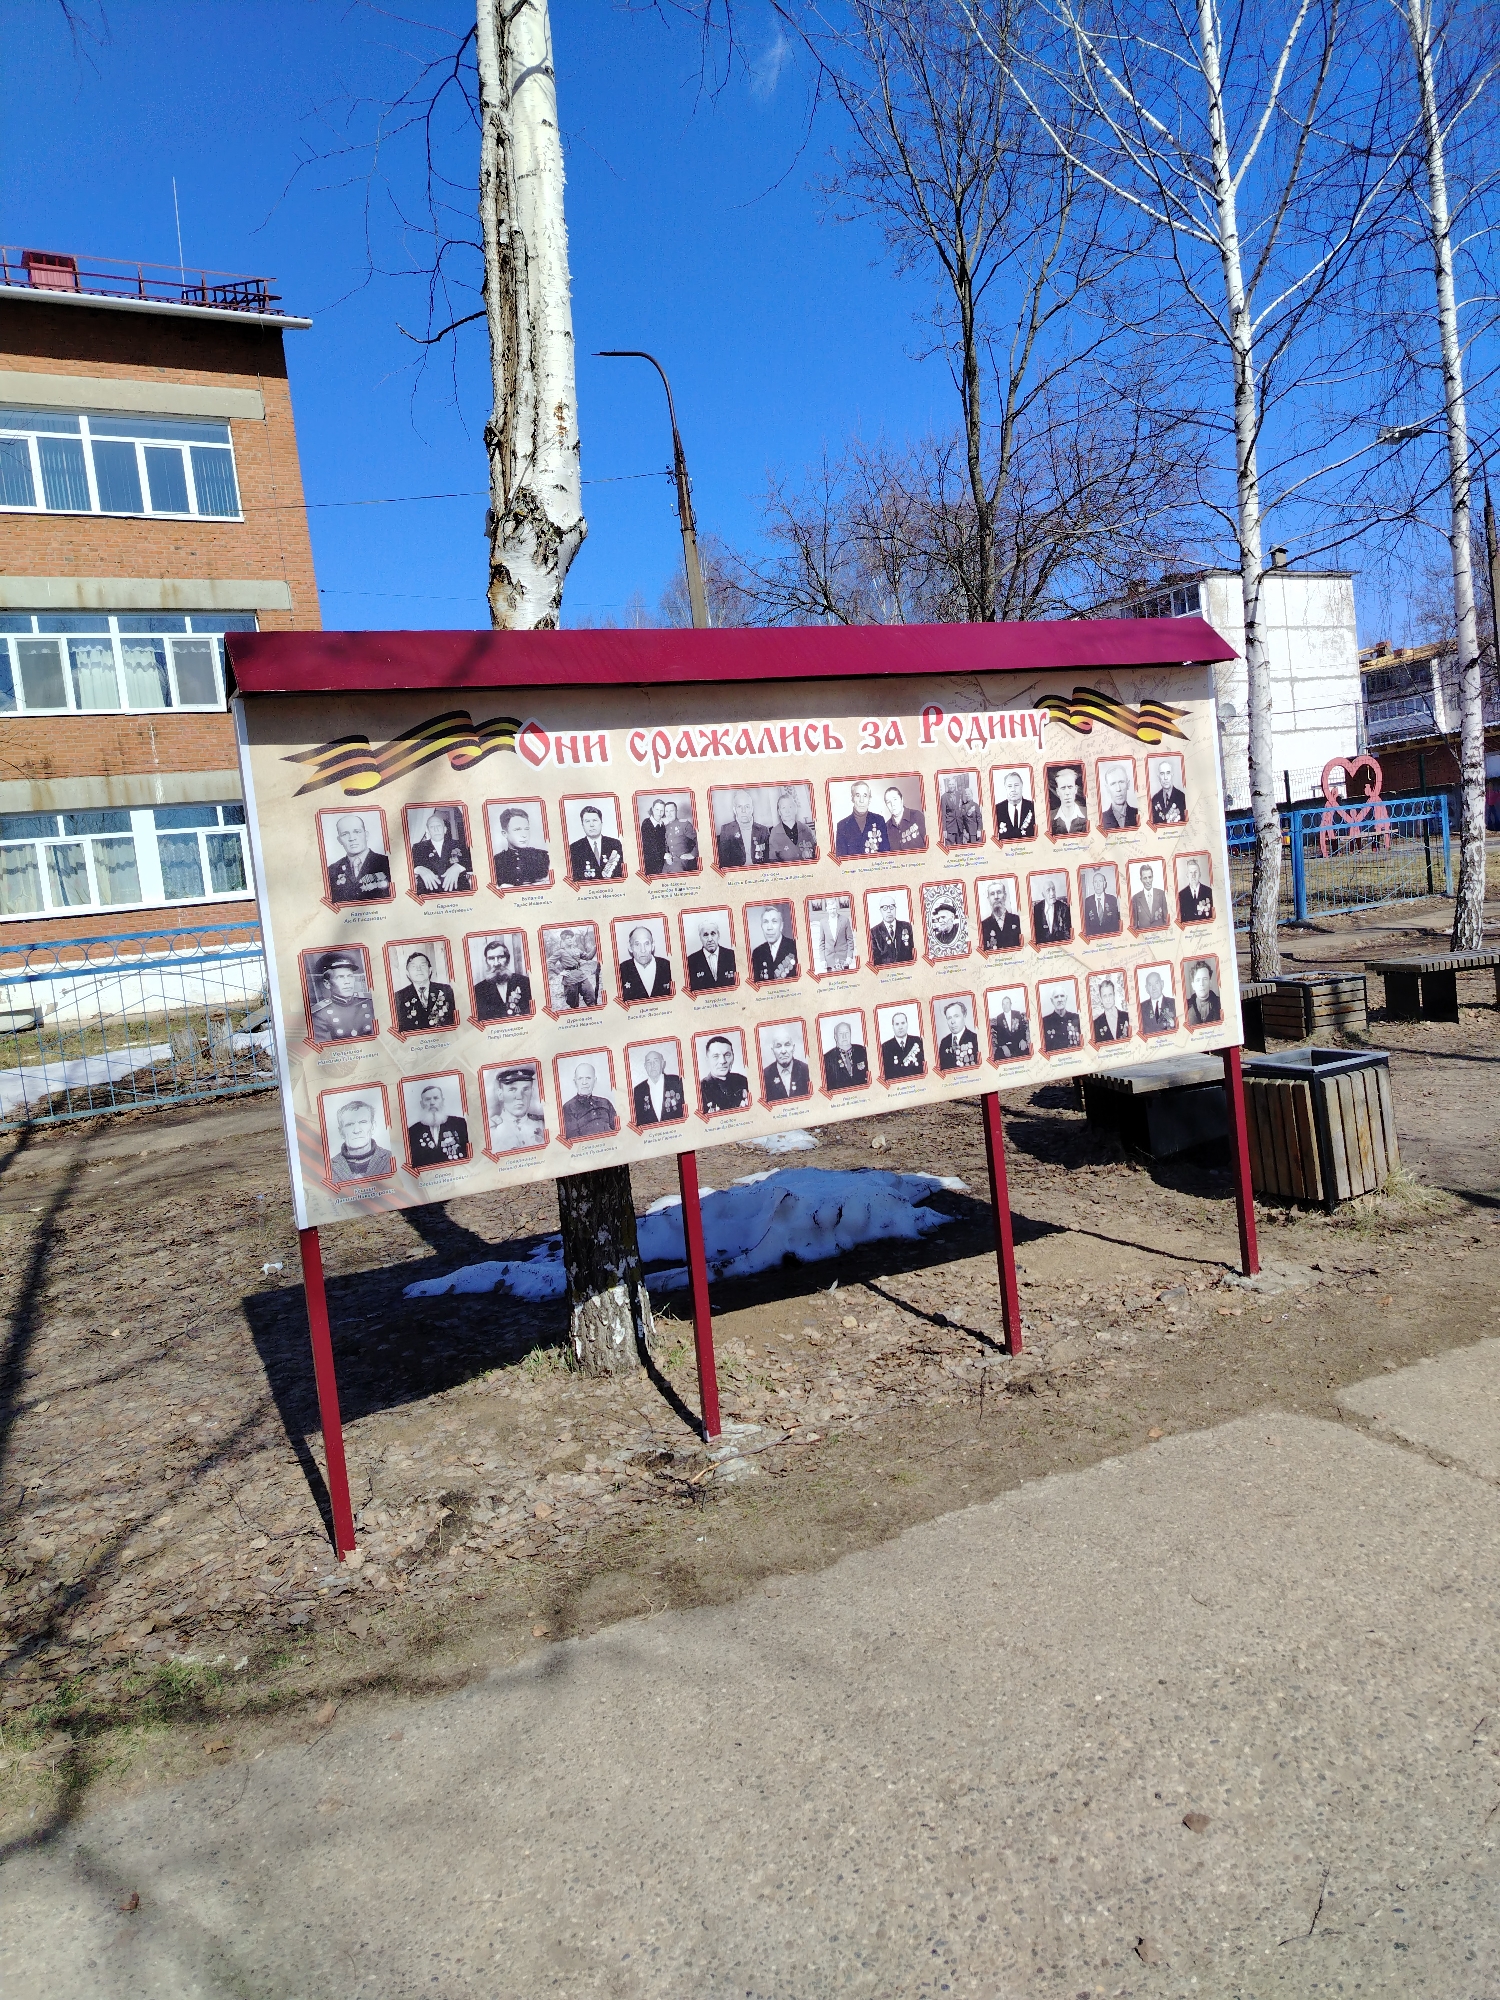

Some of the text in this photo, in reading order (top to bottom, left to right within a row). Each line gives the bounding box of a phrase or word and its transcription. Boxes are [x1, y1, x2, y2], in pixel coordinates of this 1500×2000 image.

[519, 705, 1048, 773] Они сражались за Родину
